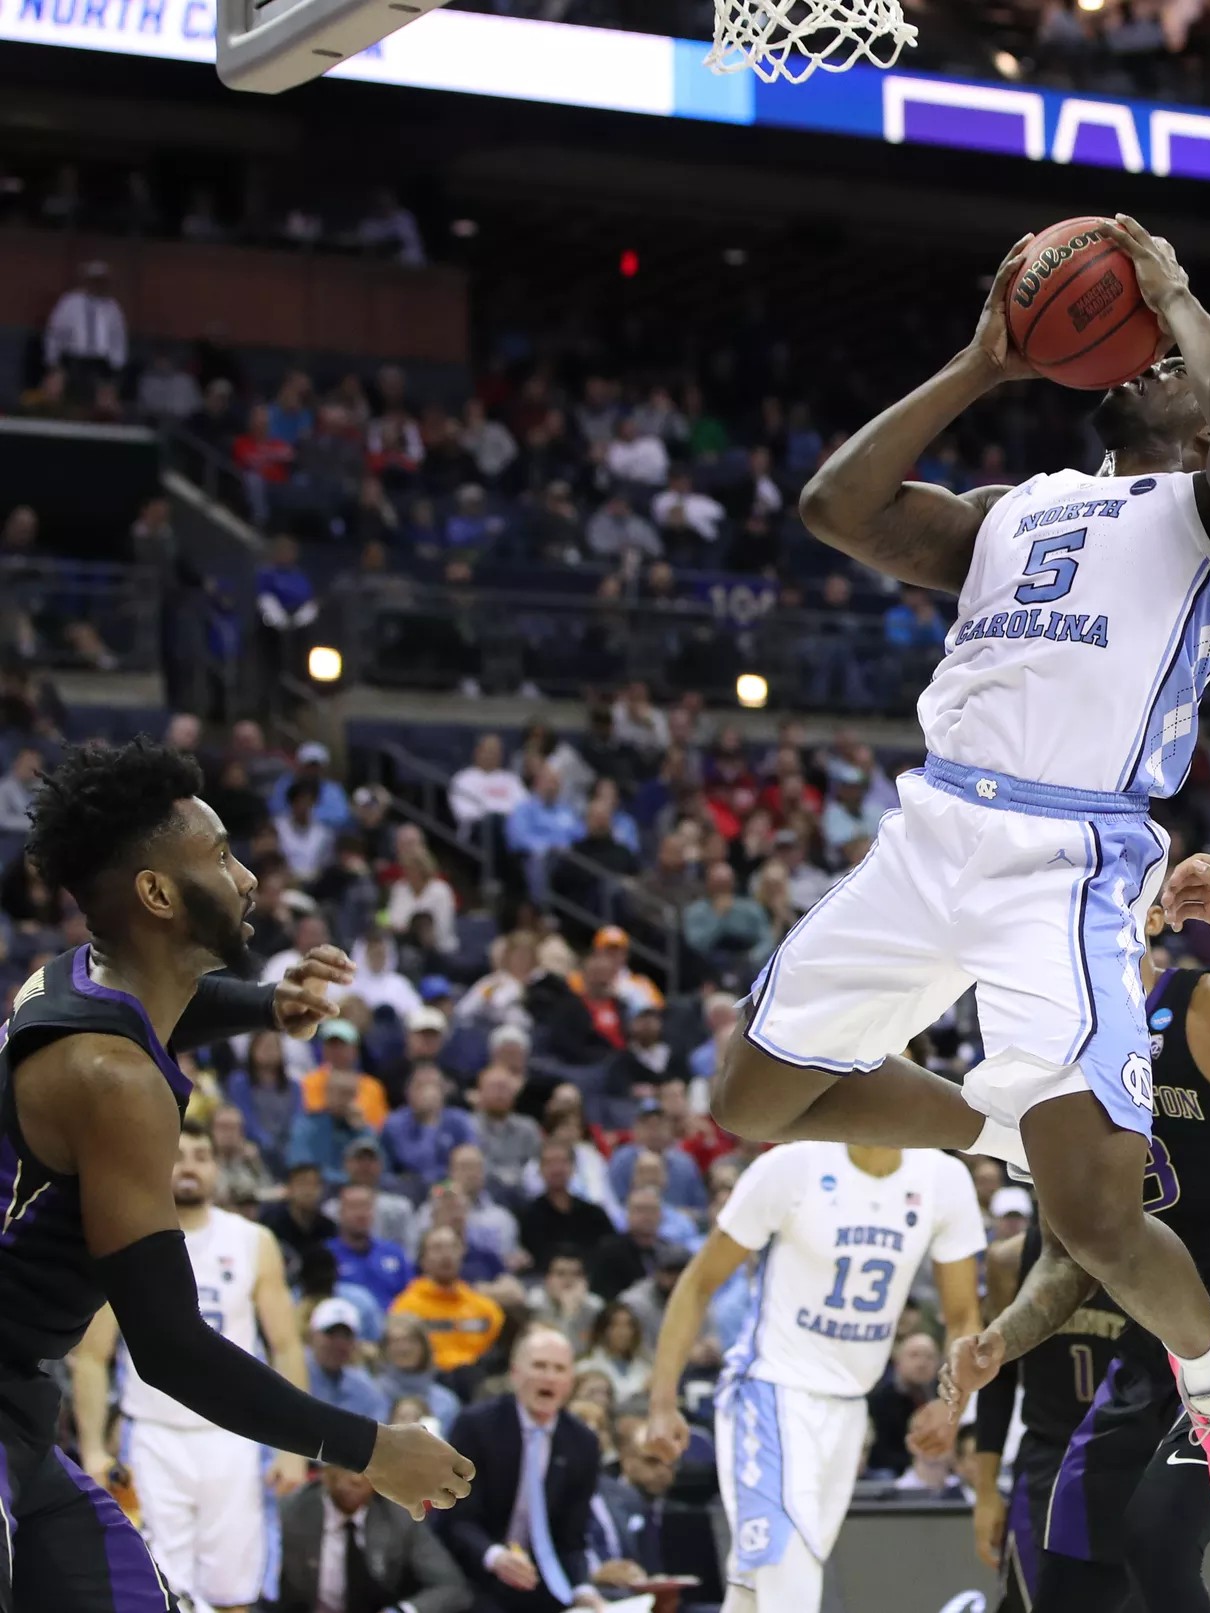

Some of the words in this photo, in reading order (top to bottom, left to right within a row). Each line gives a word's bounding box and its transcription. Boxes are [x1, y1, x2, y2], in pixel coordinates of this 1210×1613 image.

[1013, 499, 1128, 538] NORTH
[1014, 527, 1088, 605] 5
[955, 609, 1109, 648] CAROLINA
[834, 1225, 904, 1252] NORTH
[823, 1256, 895, 1312] 13
[796, 1307, 893, 1342] CAROLINA
